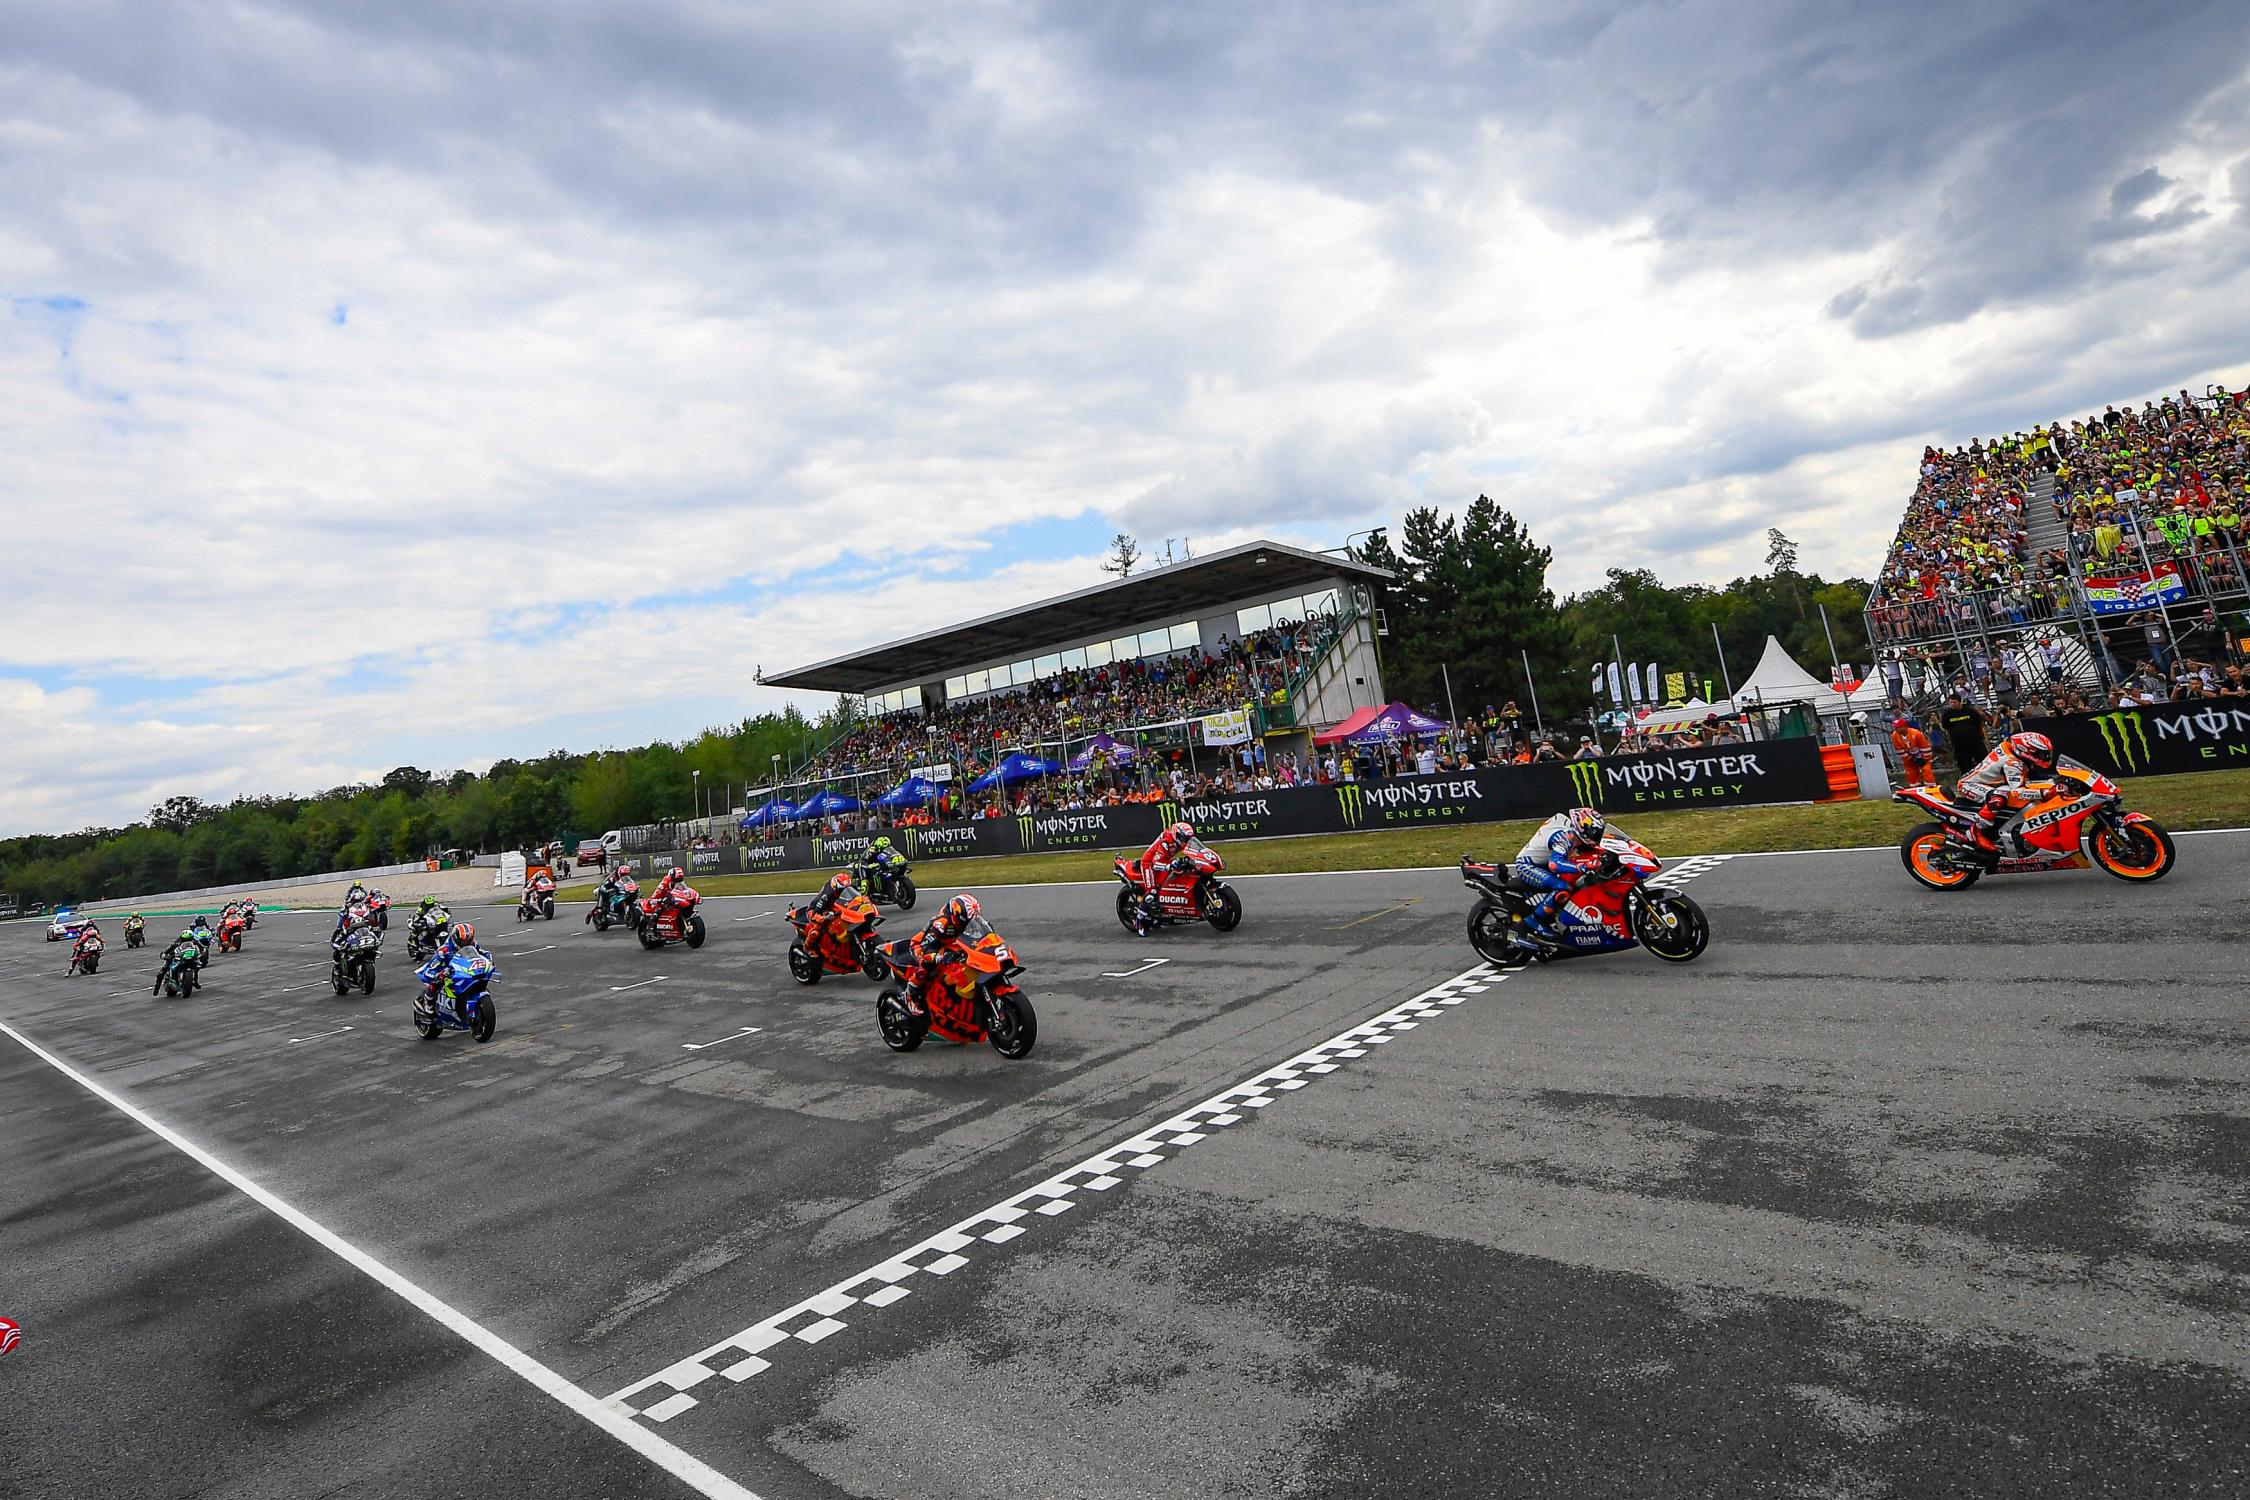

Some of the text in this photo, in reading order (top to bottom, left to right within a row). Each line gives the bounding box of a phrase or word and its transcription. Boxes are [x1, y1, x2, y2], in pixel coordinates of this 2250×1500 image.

[2089, 588, 2117, 599] VR
[2200, 744, 2248, 758] EN
[1606, 754, 1766, 788] MONSTER
[1365, 780, 1483, 808] MONSTER
[1634, 785, 1743, 801] ENERGY
[1181, 800, 1271, 823] MONSTER
[1386, 806, 1465, 820] ENERGY
[2027, 800, 2090, 829] REPSOL
[1036, 815, 1107, 835] MONSTER
[1196, 822, 1258, 834] ENERGY
[918, 826, 977, 845] MONSTER
[1048, 834, 1097, 845] ENERGY
[748, 845, 785, 861] MONSTER
[824, 837, 871, 853] MONSTER
[928, 845, 969, 854] ENERGY
[692, 852, 720, 866] MONSTER
[1160, 896, 1188, 904] DUCATI
[438, 993, 456, 1010] UKI
